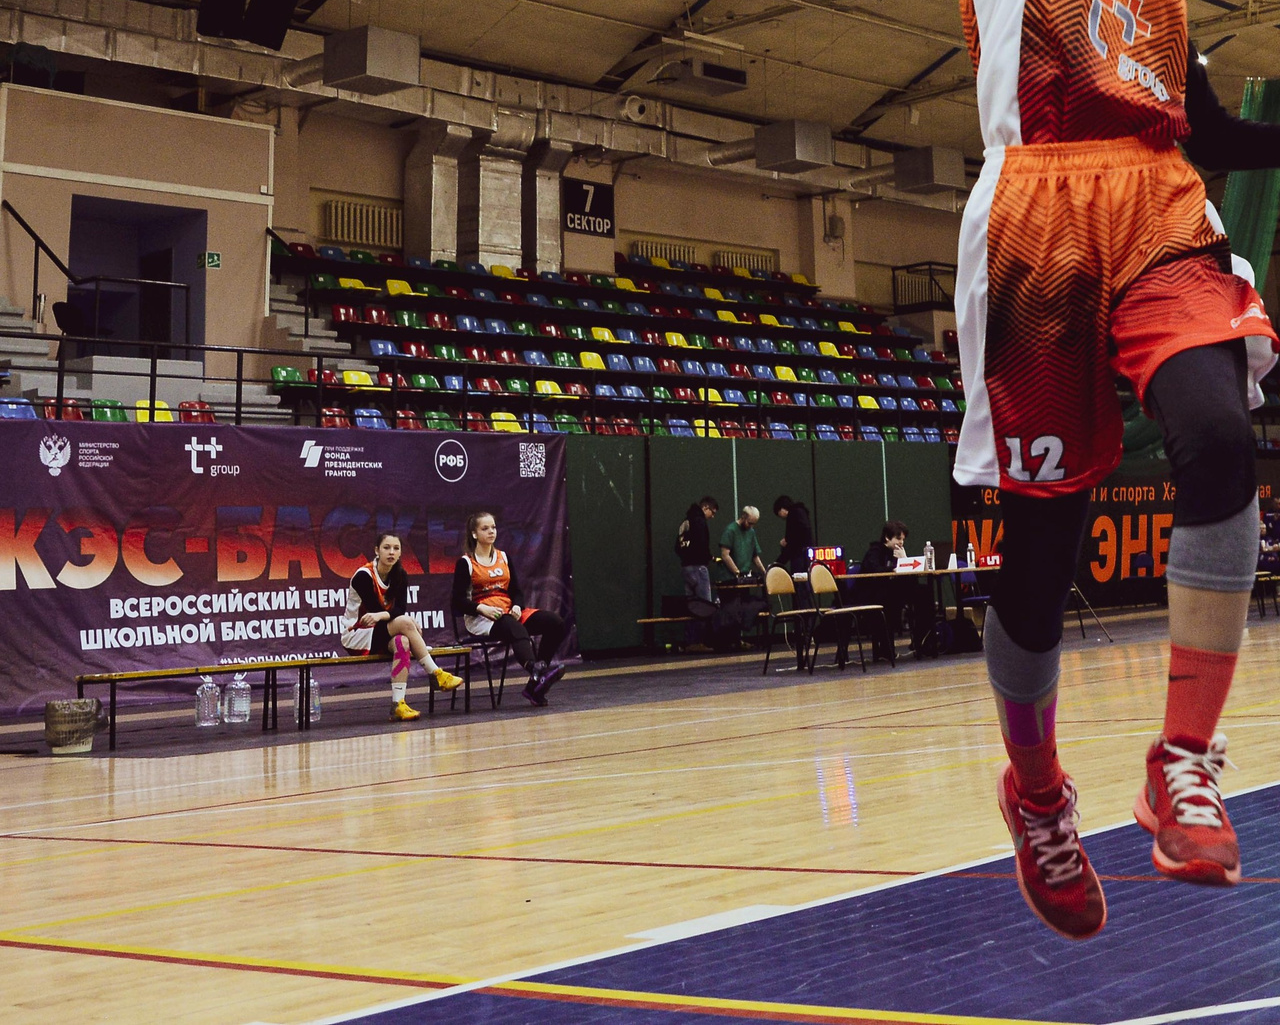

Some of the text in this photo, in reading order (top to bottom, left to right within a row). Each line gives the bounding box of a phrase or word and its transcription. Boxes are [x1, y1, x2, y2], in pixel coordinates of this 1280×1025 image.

[582, 184, 595, 213] 7
[566, 212, 611, 233] СЕКТОР
[324, 452, 351, 460] ФОНДА
[324, 461, 383, 469] ПРЕЗИДЕНТСКИХ
[438, 454, 465, 467] РФБ
[1005, 435, 1065, 482] 12
[210, 464, 240, 476] group
[1100, 485, 1108, 502] и
[1112, 483, 1155, 507] спорта
[487, 567, 504, 578] 10
[109, 586, 300, 619] ВСЕРОССИЙСКИЙ
[79, 618, 217, 651] ШКОЛЬНОЙ
